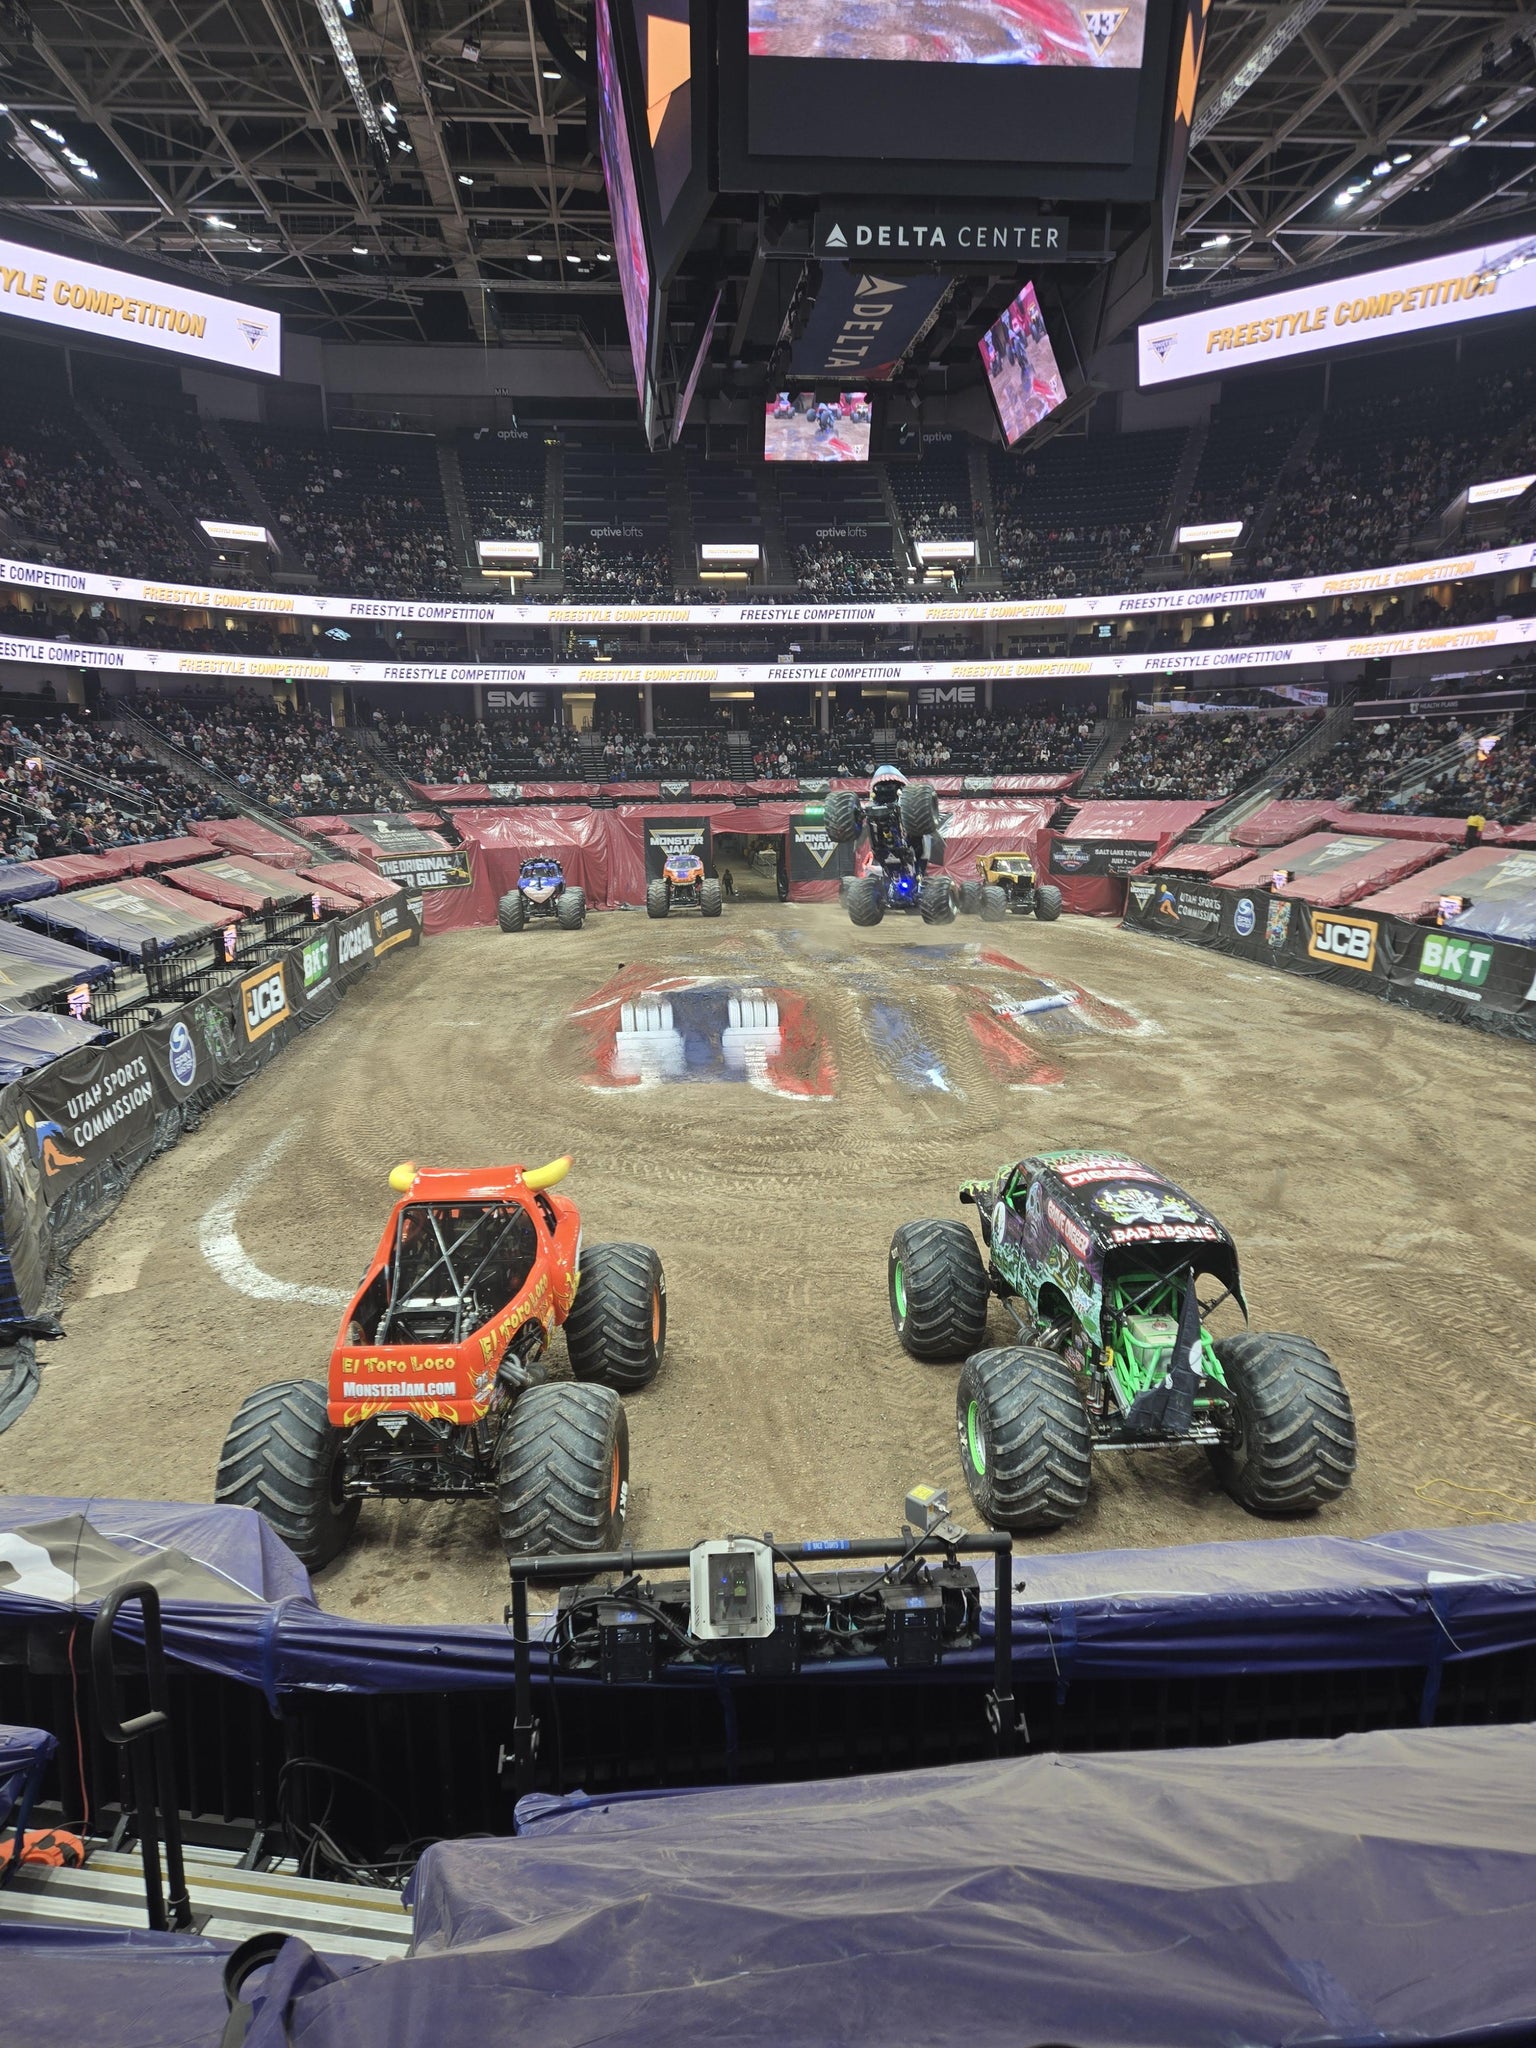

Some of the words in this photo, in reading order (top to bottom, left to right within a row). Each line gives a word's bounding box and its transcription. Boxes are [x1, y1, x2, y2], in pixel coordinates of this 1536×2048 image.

[856, 226, 946, 247] DELTA
[958, 227, 1059, 248] CENTER
[54, 280, 207, 338] COMPETITION
[1206, 306, 1328, 354] FREESTYLE
[1333, 272, 1498, 326] COMPETITION
[824, 304, 894, 369] DELTA
[10, 565, 86, 590] COMPETITION
[1322, 575, 1391, 594] FREESTYLE
[1393, 560, 1477, 585] COMPETITION
[143, 586, 210, 606] FREESTYLE
[213, 593, 295, 612] COMPETITION
[1119, 594, 1185, 611] FREESTYLE
[1188, 587, 1267, 606] COMPETITION
[350, 603, 415, 618] FREESTYLE
[418, 606, 495, 620] COMPETITION
[548, 610, 612, 622] FREESTYLE
[613, 610, 690, 622] COMPETITION
[740, 609, 800, 620] FREESTYLE
[803, 608, 876, 620] COMPETITION
[925, 607, 988, 619] FREESTYLE
[989, 603, 1066, 619] COMPETITION
[1347, 638, 1413, 657] FREESTYLE
[1416, 629, 1499, 652] COMPETITION
[48, 646, 124, 666] COMPETITION
[1145, 654, 1210, 669] FREESTYLE
[1212, 648, 1293, 666] COMPETITION
[178, 658, 246, 674] FREESTYLE
[247, 661, 330, 678] COMPETITION
[384, 667, 449, 680] FREESTYLE
[451, 668, 526, 681] COMPETITION
[578, 669, 642, 681] FREESTYLE
[644, 669, 719, 681] COMPETITION
[768, 668, 828, 679] FREESTYLE
[830, 667, 901, 679] COMPETITION
[951, 665, 1014, 678] FREESTYLE
[1015, 662, 1093, 676] COMPETITION
[917, 686, 976, 704] SME
[650, 836, 704, 846] MONSTER
[795, 833, 833, 843] MONST
[809, 842, 836, 851] JAM
[666, 845, 691, 855] JAM
[381, 860, 400, 875] THE
[400, 856, 452, 873] ORIGINAL
[416, 871, 449, 886] GLUE
[1180, 892, 1197, 904] UTAH
[1198, 896, 1221, 910] SPORTS
[1178, 905, 1220, 922] COMMISSION
[1316, 923, 1371, 959] JCB
[303, 942, 328, 982] BKT
[1422, 941, 1490, 978] BKT
[248, 975, 285, 1026] JCB
[67, 1083, 102, 1119] UTAH
[103, 1056, 147, 1097] SPORTS
[73, 1081, 153, 1148] COMMISSION
[1114, 1228, 1151, 1242] BAD
[1163, 1225, 1217, 1240] BONE
[342, 1358, 359, 1374] El
[364, 1357, 406, 1373] Toro
[410, 1355, 455, 1372] Loco
